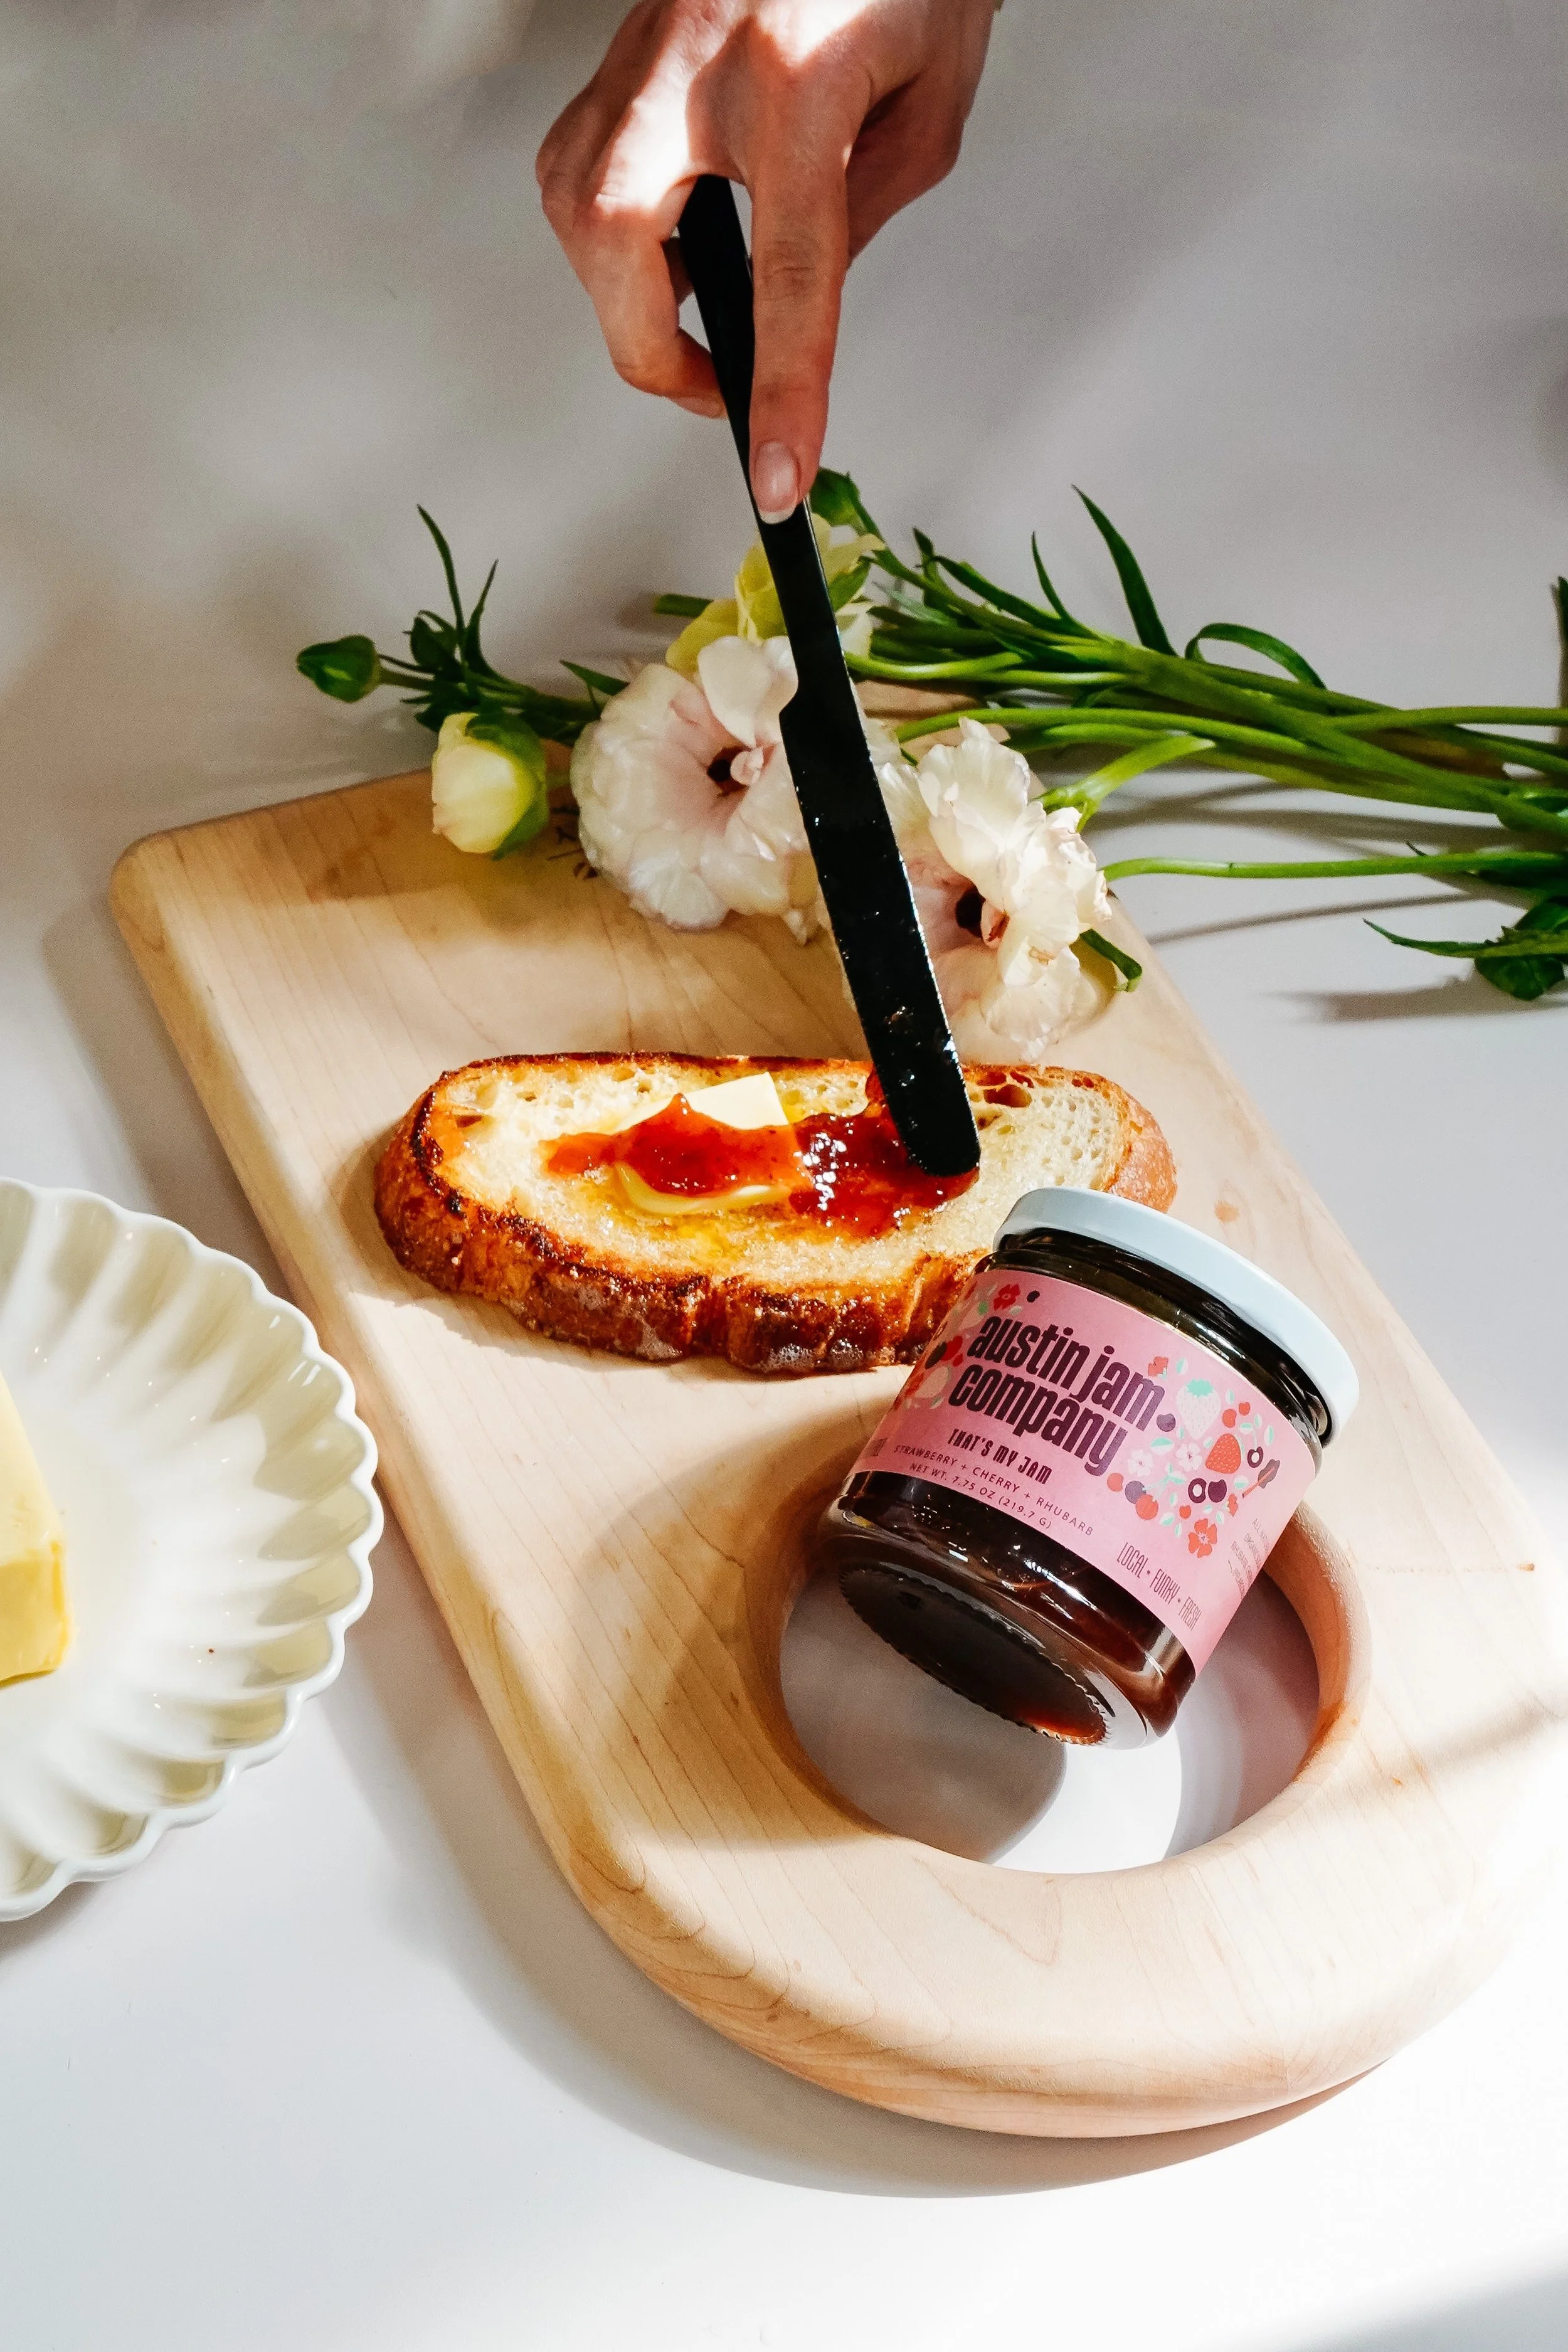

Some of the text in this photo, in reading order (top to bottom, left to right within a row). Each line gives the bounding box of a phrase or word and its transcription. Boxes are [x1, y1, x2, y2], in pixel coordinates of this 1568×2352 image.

[967, 1316, 1165, 1431] austin jam
[947, 1429, 1052, 1485] THAT'S MY JAM
[948, 1364, 1128, 1476] company
[893, 1444, 958, 1466] STRAWBERRY
[973, 1466, 1020, 1493] CHERRY
[1036, 1496, 1094, 1535] RHUBARB
[909, 1463, 1052, 1529] NET WT. 7.75 OZ (219.7 G)
[1116, 1542, 1202, 1631] LOCAL FUNKY FRESH
